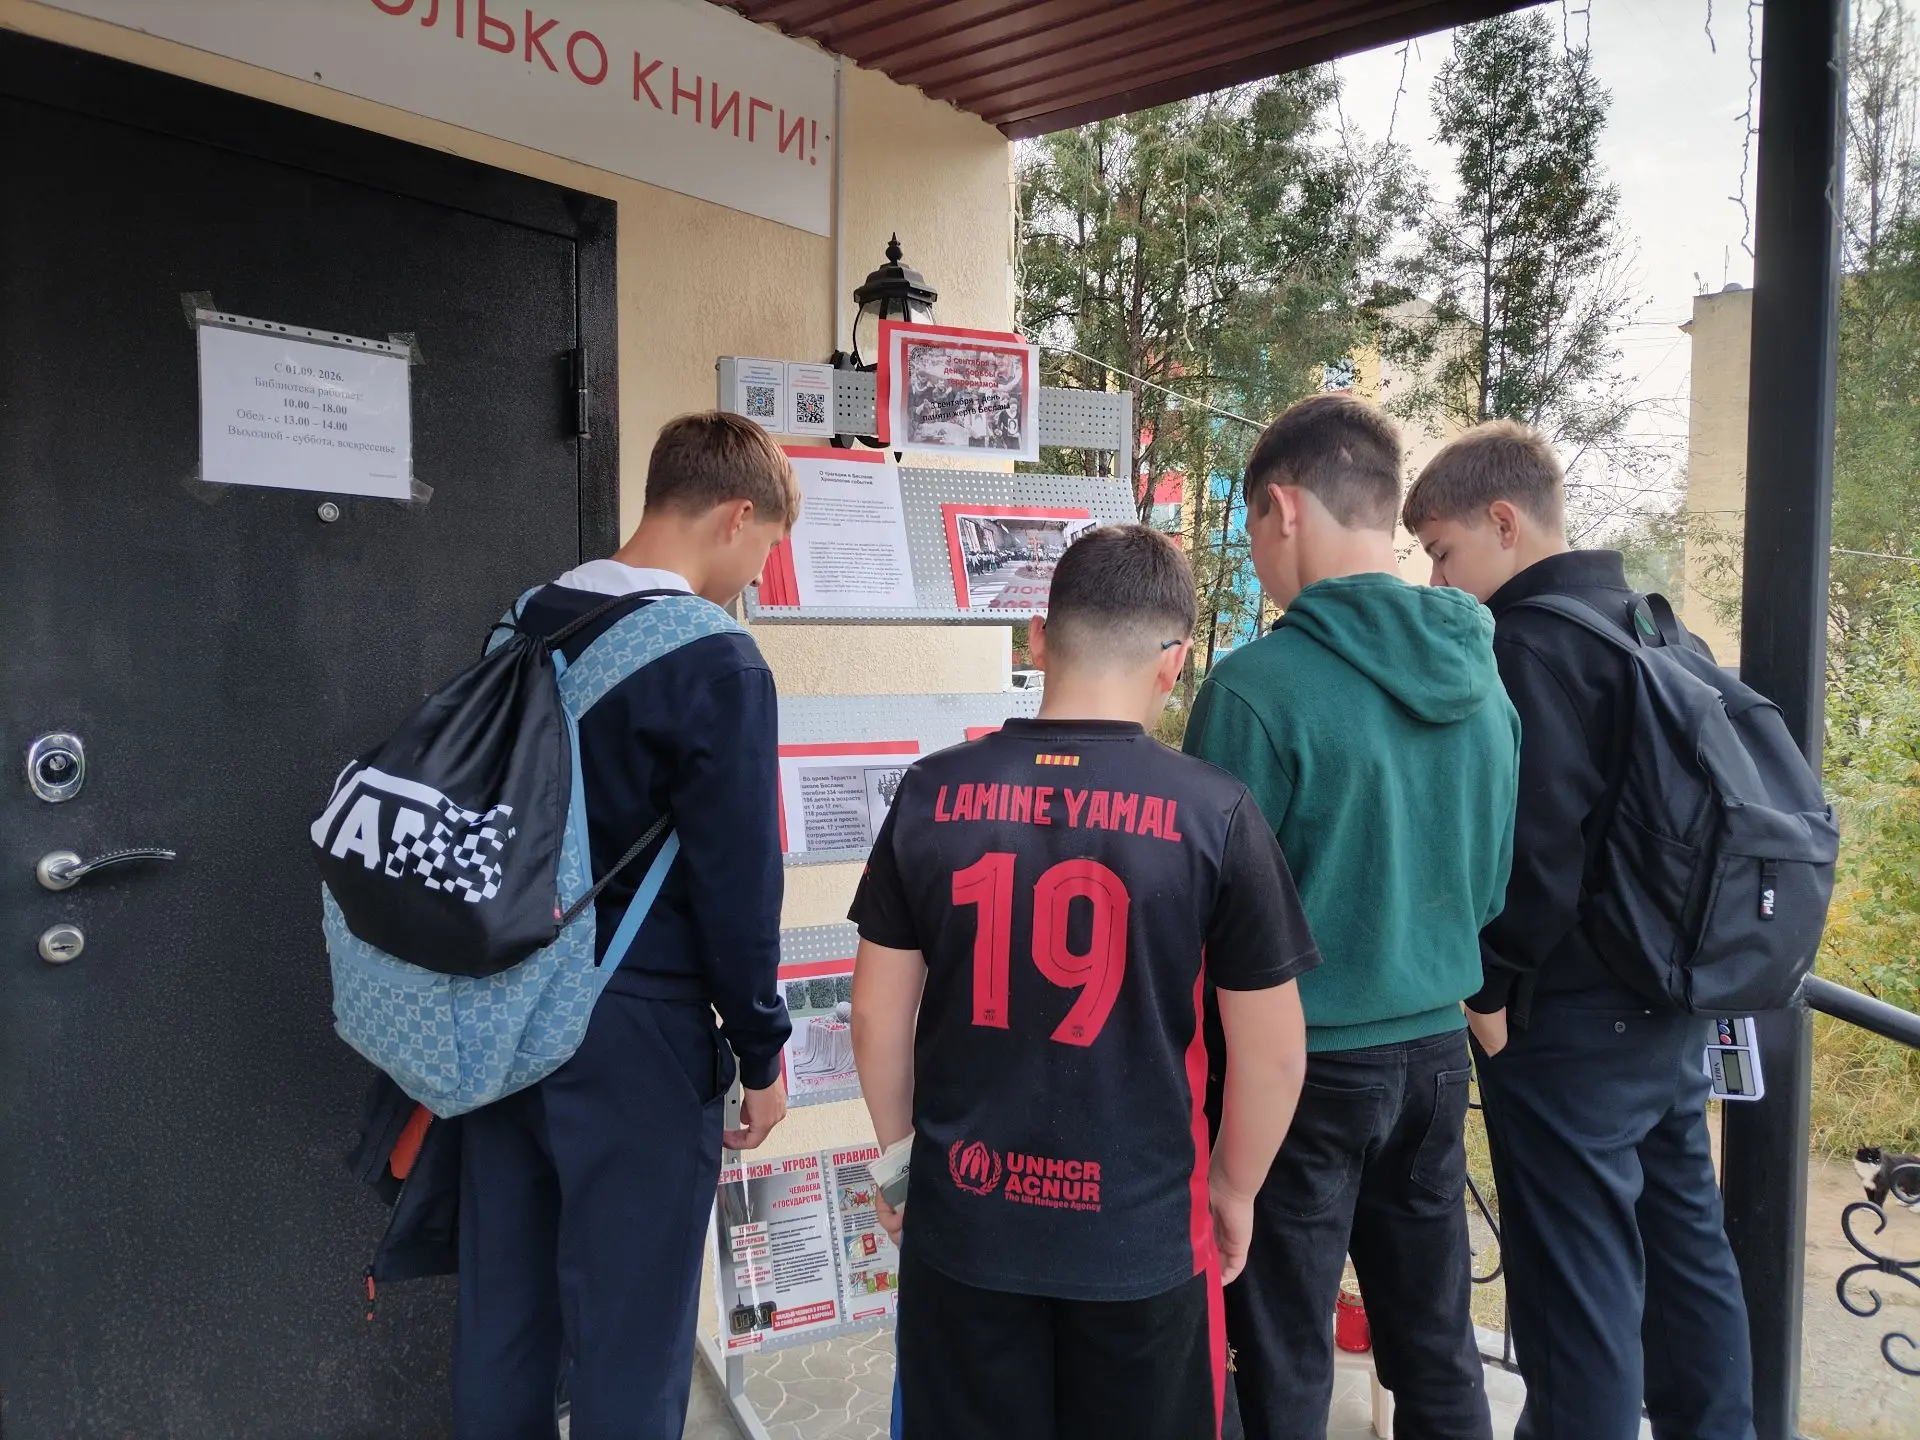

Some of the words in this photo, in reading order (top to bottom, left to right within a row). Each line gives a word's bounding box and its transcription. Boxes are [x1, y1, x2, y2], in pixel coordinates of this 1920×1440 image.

[371, 0, 608, 86] ЛЬКО
[632, 51, 818, 166] КНИГИ!
[274, 362, 283, 373] С
[953, 357, 990, 368] сентября
[965, 369, 996, 379] борьбы
[255, 376, 315, 395] Библиотека
[947, 378, 999, 389] терроризмом
[283, 397, 310, 410] 10.00
[322, 402, 347, 415] 18.00
[938, 397, 974, 408] сентября
[236, 408, 264, 421] Обед
[283, 414, 310, 427] 13.00
[322, 419, 348, 431] 14.00
[227, 425, 284, 440] Выходной
[337, 439, 396, 454] воскресенье
[934, 783, 1054, 825] LAMINE
[1063, 788, 1182, 842] YAMAL
[951, 852, 1131, 1047] 19
[782, 1156, 818, 1173] УГРОЗА
[832, 1148, 880, 1166] ПРАВИЛА
[1006, 1152, 1101, 1181] UNHCR
[806, 1171, 820, 1182] ДЛЯ
[789, 1182, 821, 1195] ЧЕЛОВЕКА
[1004, 1173, 1101, 1202] ACNUR
[777, 1193, 823, 1209] ГОСУДАРСТВА
[1005, 1192, 1020, 1202] The
[1021, 1195, 1034, 1205] UN
[1034, 1196, 1069, 1211] Refugee
[1070, 1201, 1101, 1213] Agency
